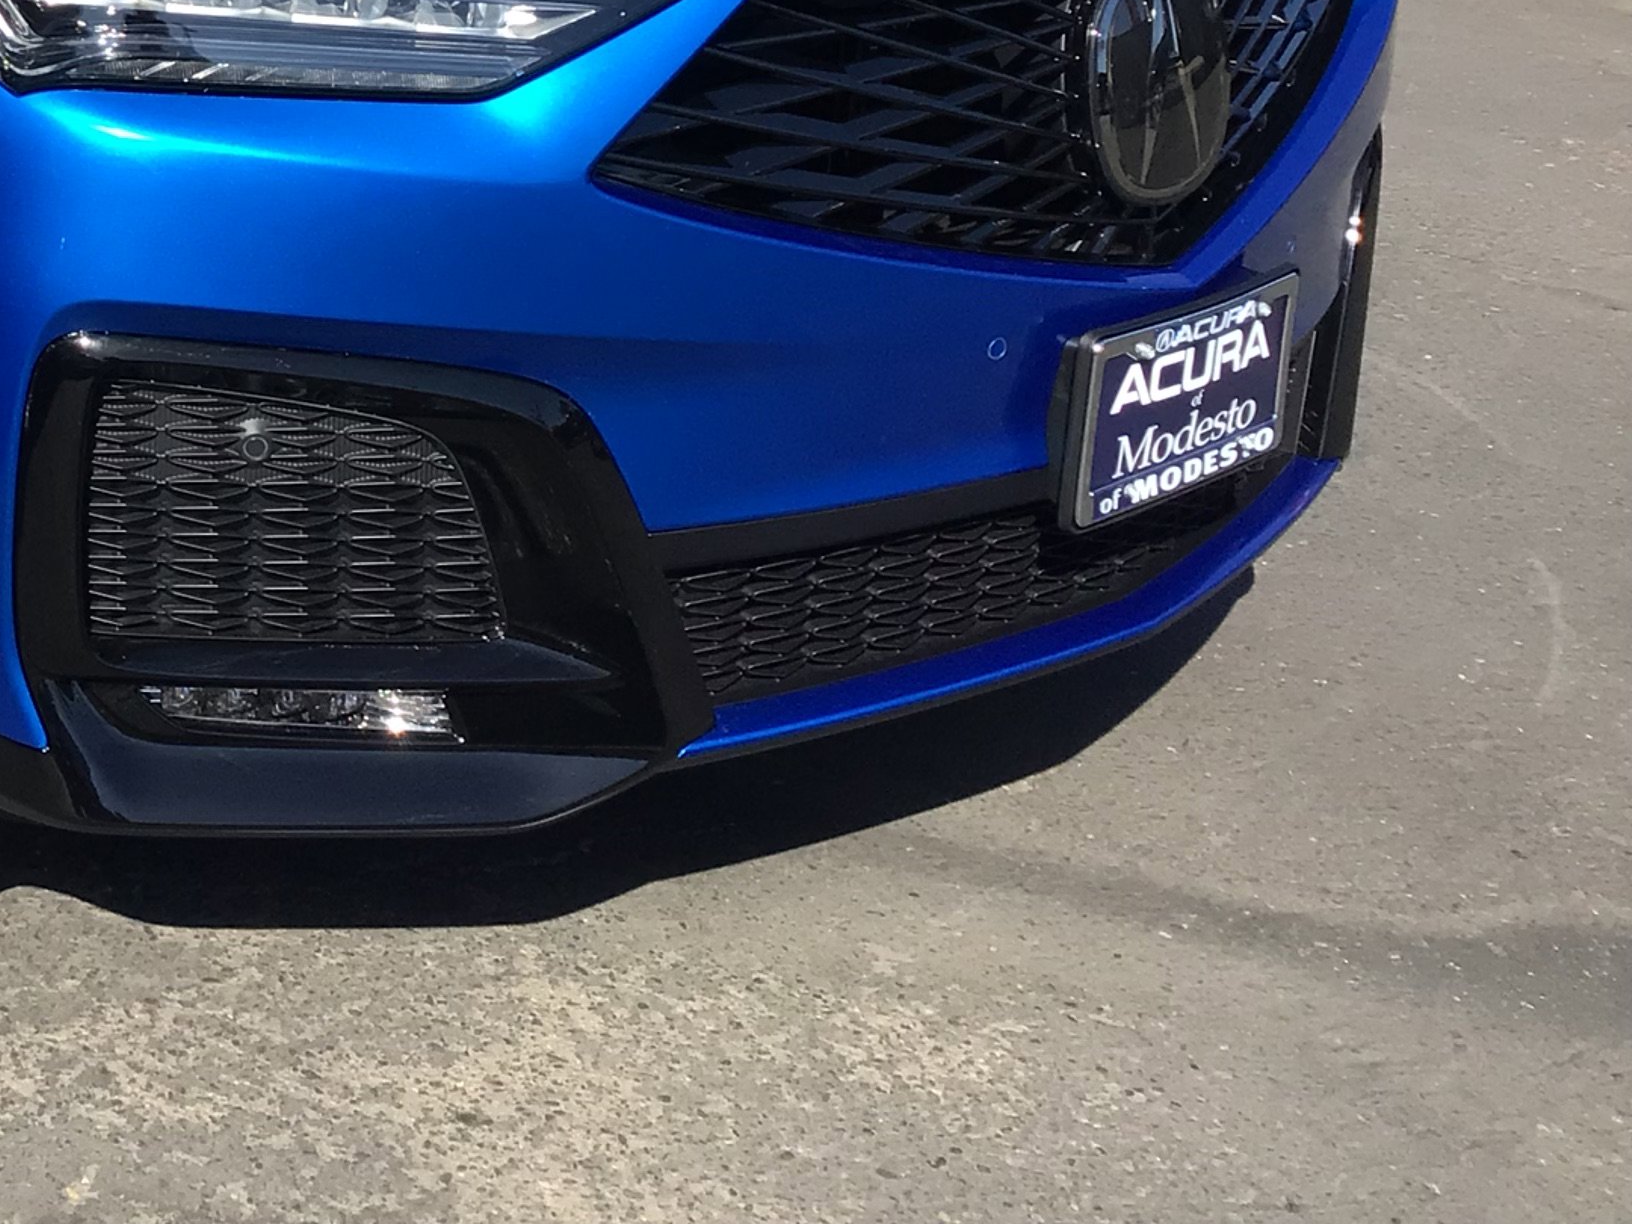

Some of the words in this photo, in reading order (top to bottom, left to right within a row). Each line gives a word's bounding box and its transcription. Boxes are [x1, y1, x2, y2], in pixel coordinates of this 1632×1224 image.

[1173, 299, 1257, 347] ACURA
[1109, 319, 1270, 416] ACURA
[1190, 388, 1205, 407] of
[1099, 487, 1122, 515] of
[1123, 427, 1275, 503] MODESTO
[1111, 397, 1257, 479] Modesto
